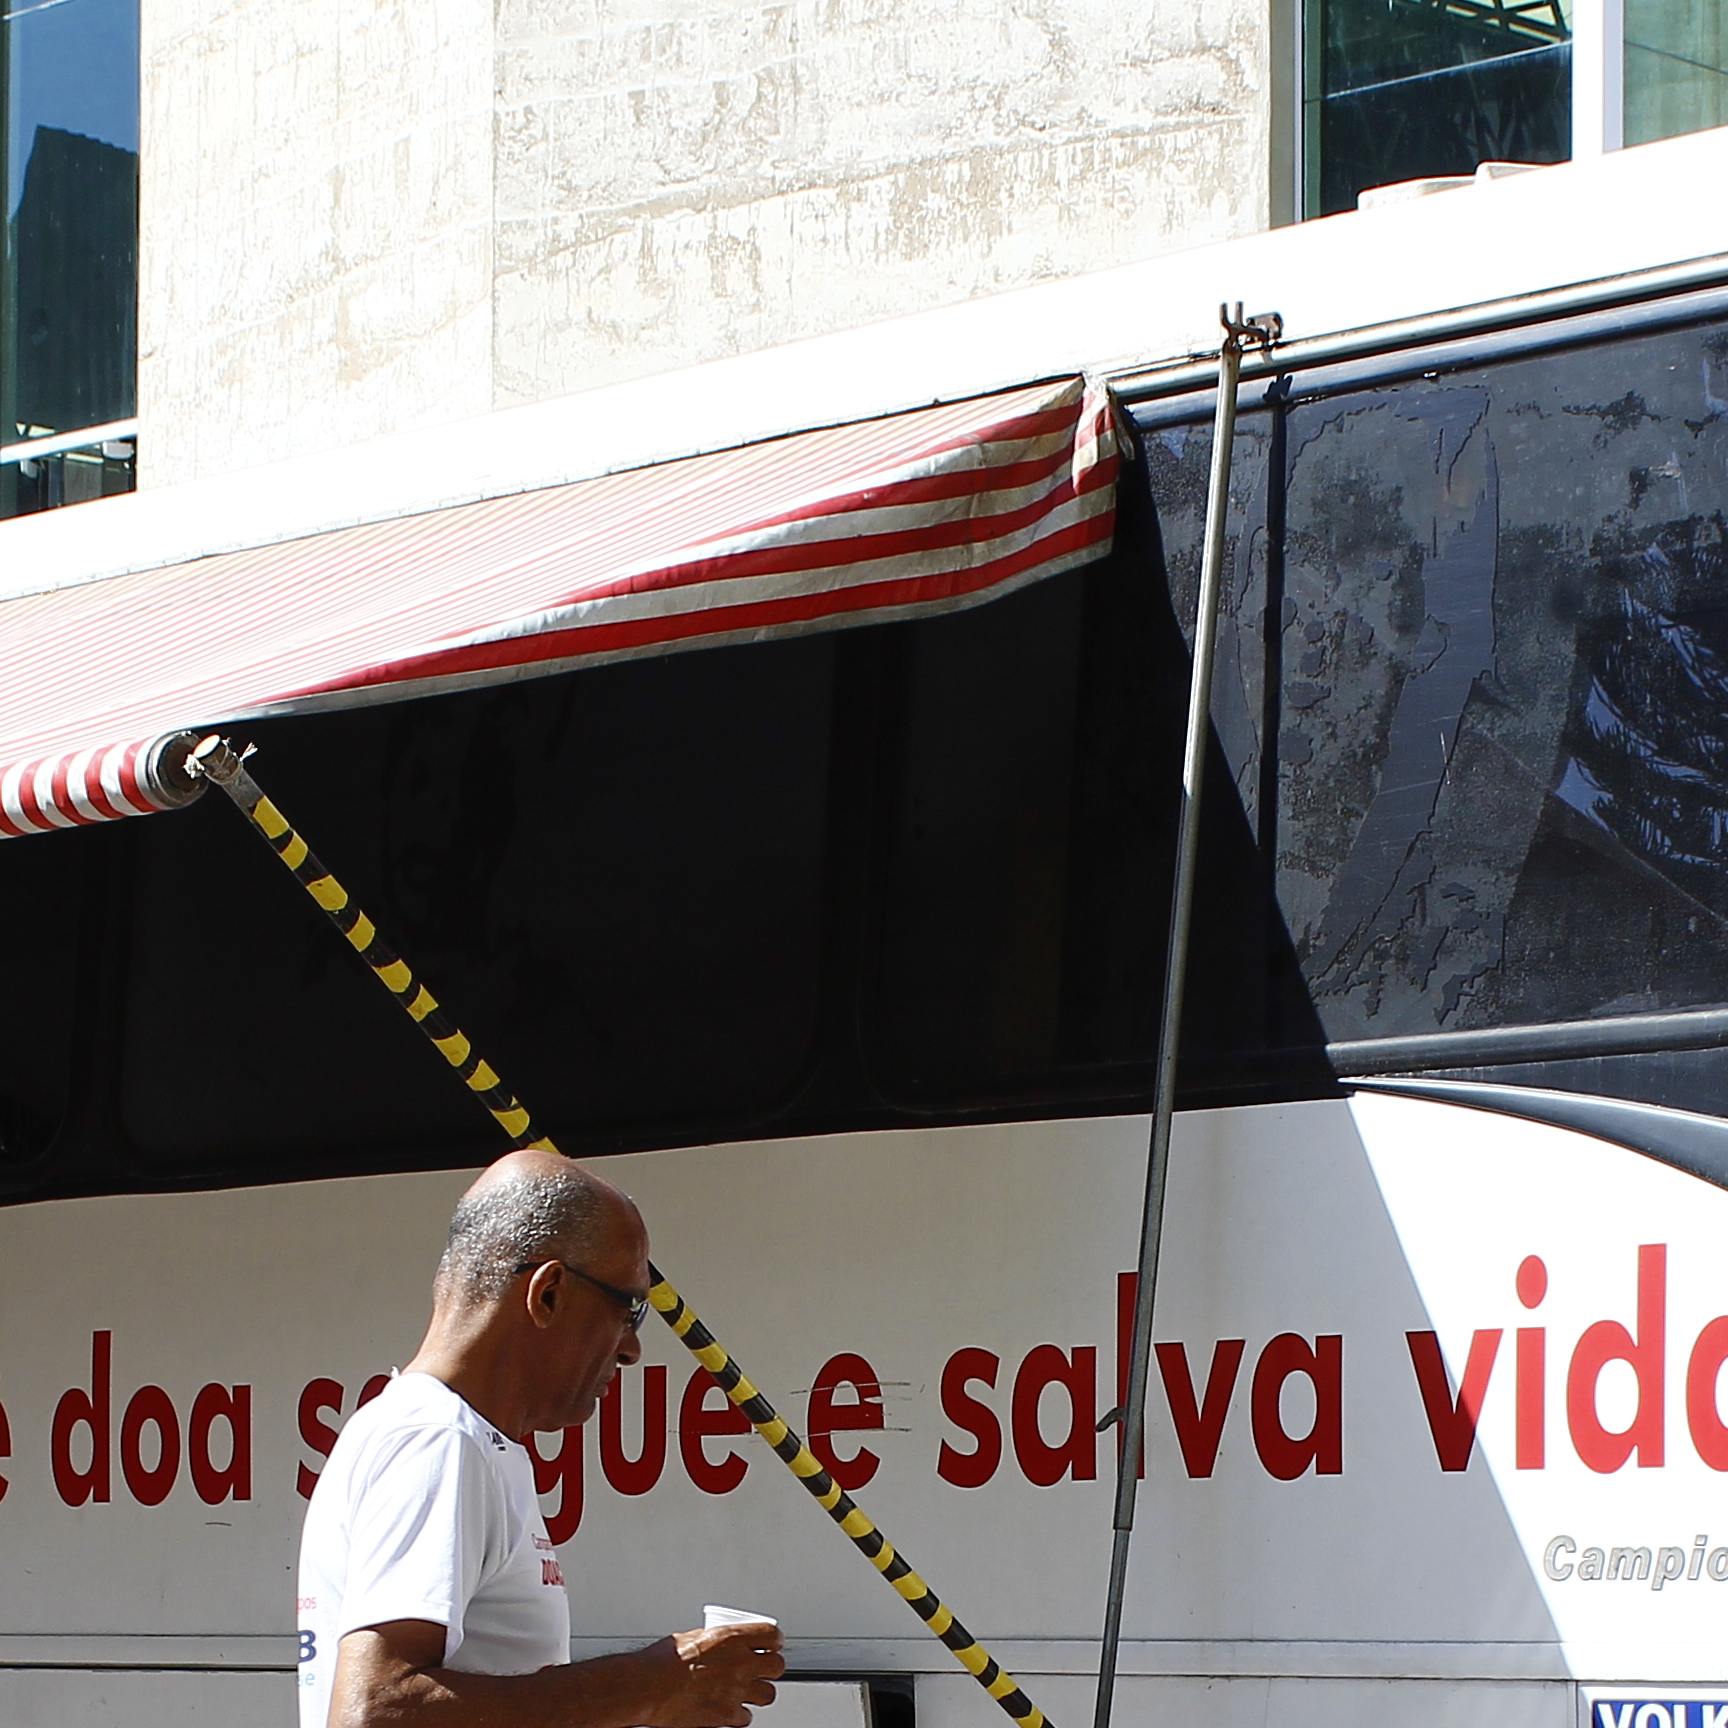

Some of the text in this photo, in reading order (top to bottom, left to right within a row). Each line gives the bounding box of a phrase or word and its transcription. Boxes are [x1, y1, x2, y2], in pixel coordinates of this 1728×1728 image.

[50, 1329, 252, 1508] doa
[296, 1363, 754, 1547] sgue
[807, 1352, 886, 1491] e
